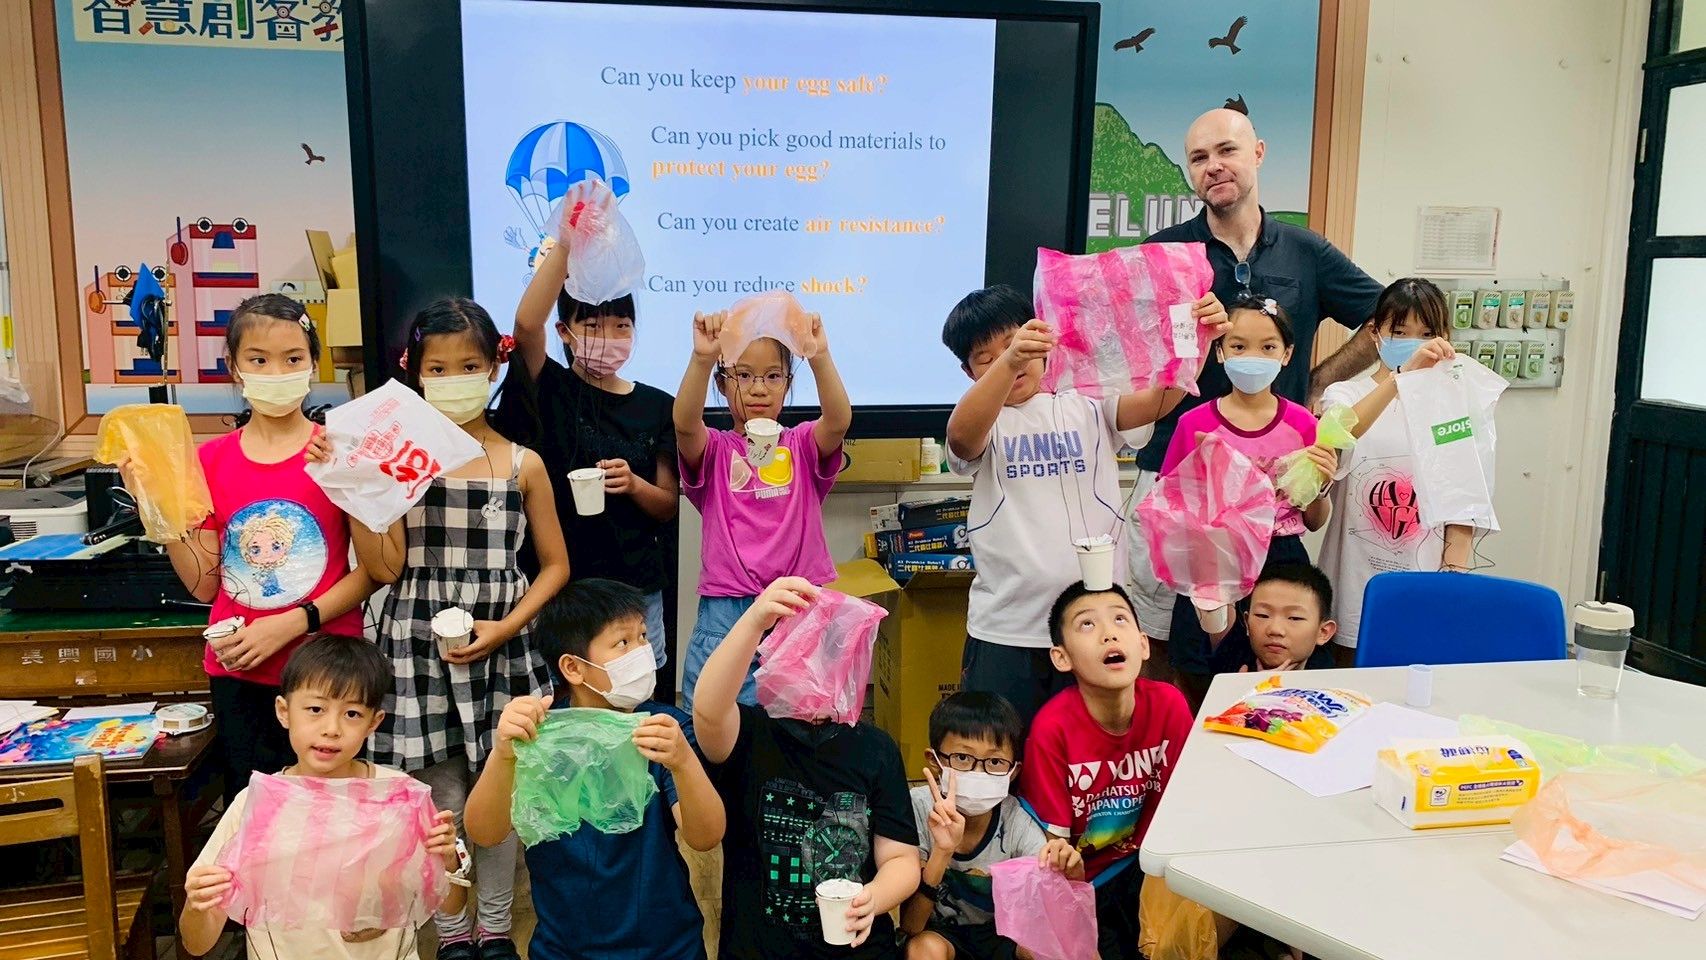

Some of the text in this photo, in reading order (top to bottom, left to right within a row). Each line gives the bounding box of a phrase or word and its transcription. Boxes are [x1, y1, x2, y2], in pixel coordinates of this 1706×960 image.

[600, 66, 889, 97] Can you keep your egg safe?
[651, 125, 947, 153] Can you pick good materials to
[651, 159, 833, 183] protect your egg?
[657, 212, 946, 235] Can you create air resistance?
[648, 274, 869, 297] Can you reduce shock?
[1003, 430, 1083, 462] VANGU
[1006, 459, 1086, 479] SPORTS
[1086, 785, 1140, 803] DAHATSU
[1086, 798, 1120, 815] JAPAN
